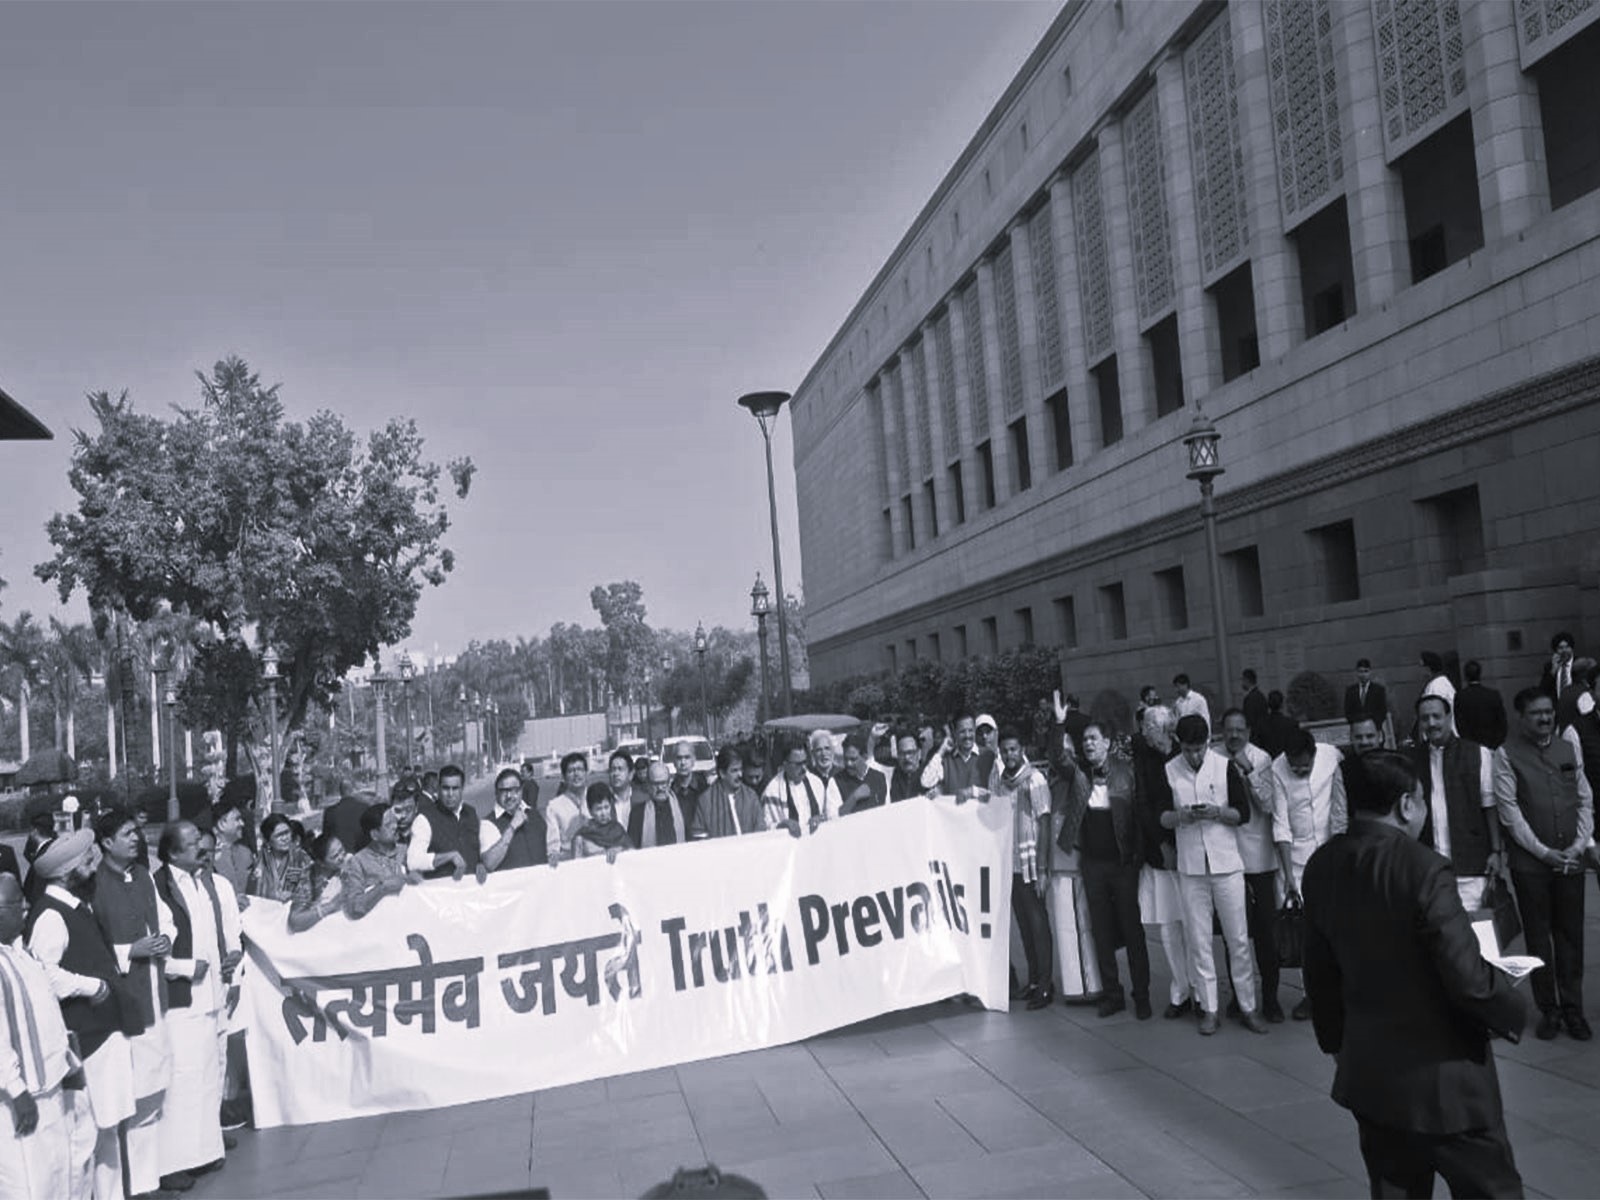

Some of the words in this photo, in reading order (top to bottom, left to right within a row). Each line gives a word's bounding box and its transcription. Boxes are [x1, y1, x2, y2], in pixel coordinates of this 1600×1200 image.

[498, 902, 642, 1002] जयते
[661, 903, 794, 991] Truth
[798, 860, 969, 965] Prevails
